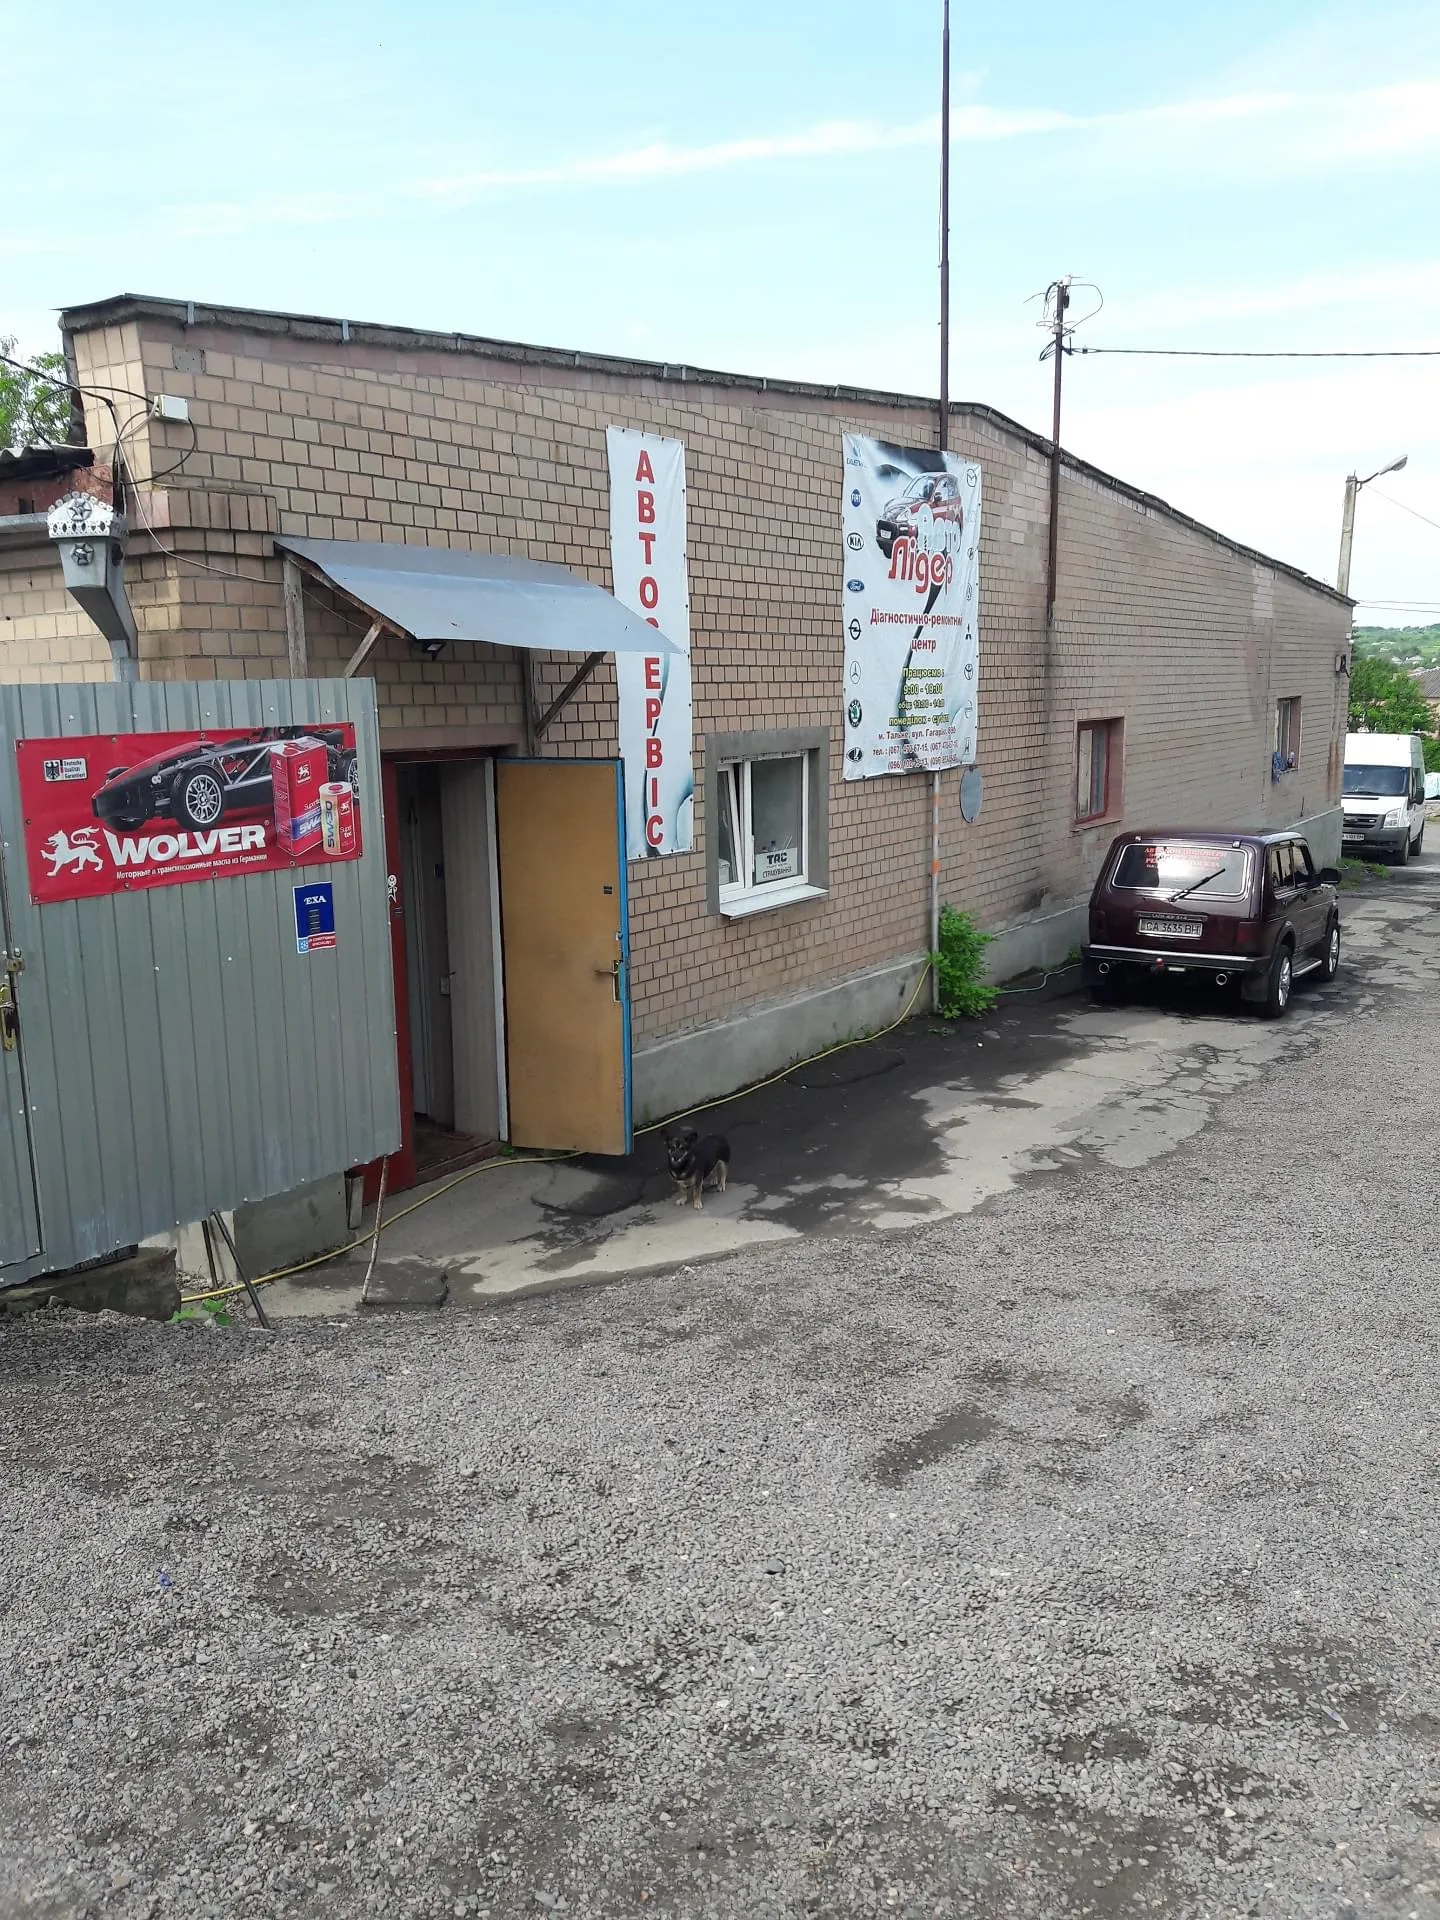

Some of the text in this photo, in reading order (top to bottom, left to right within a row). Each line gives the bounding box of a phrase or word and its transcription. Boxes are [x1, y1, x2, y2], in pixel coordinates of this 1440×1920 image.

[850, 538, 861, 547] KIA
[888, 537, 953, 595] Лідер
[911, 639, 936, 652] центр
[903, 684, 919, 695] 9:00
[911, 729, 924, 739] вул.
[103, 824, 266, 867] WOLVER
[116, 869, 151, 880] Моторные
[157, 861, 213, 876] трансмиссионные
[212, 858, 231, 867] масла
[304, 895, 327, 905] EXA
[1162, 922, 1183, 933] 3635
